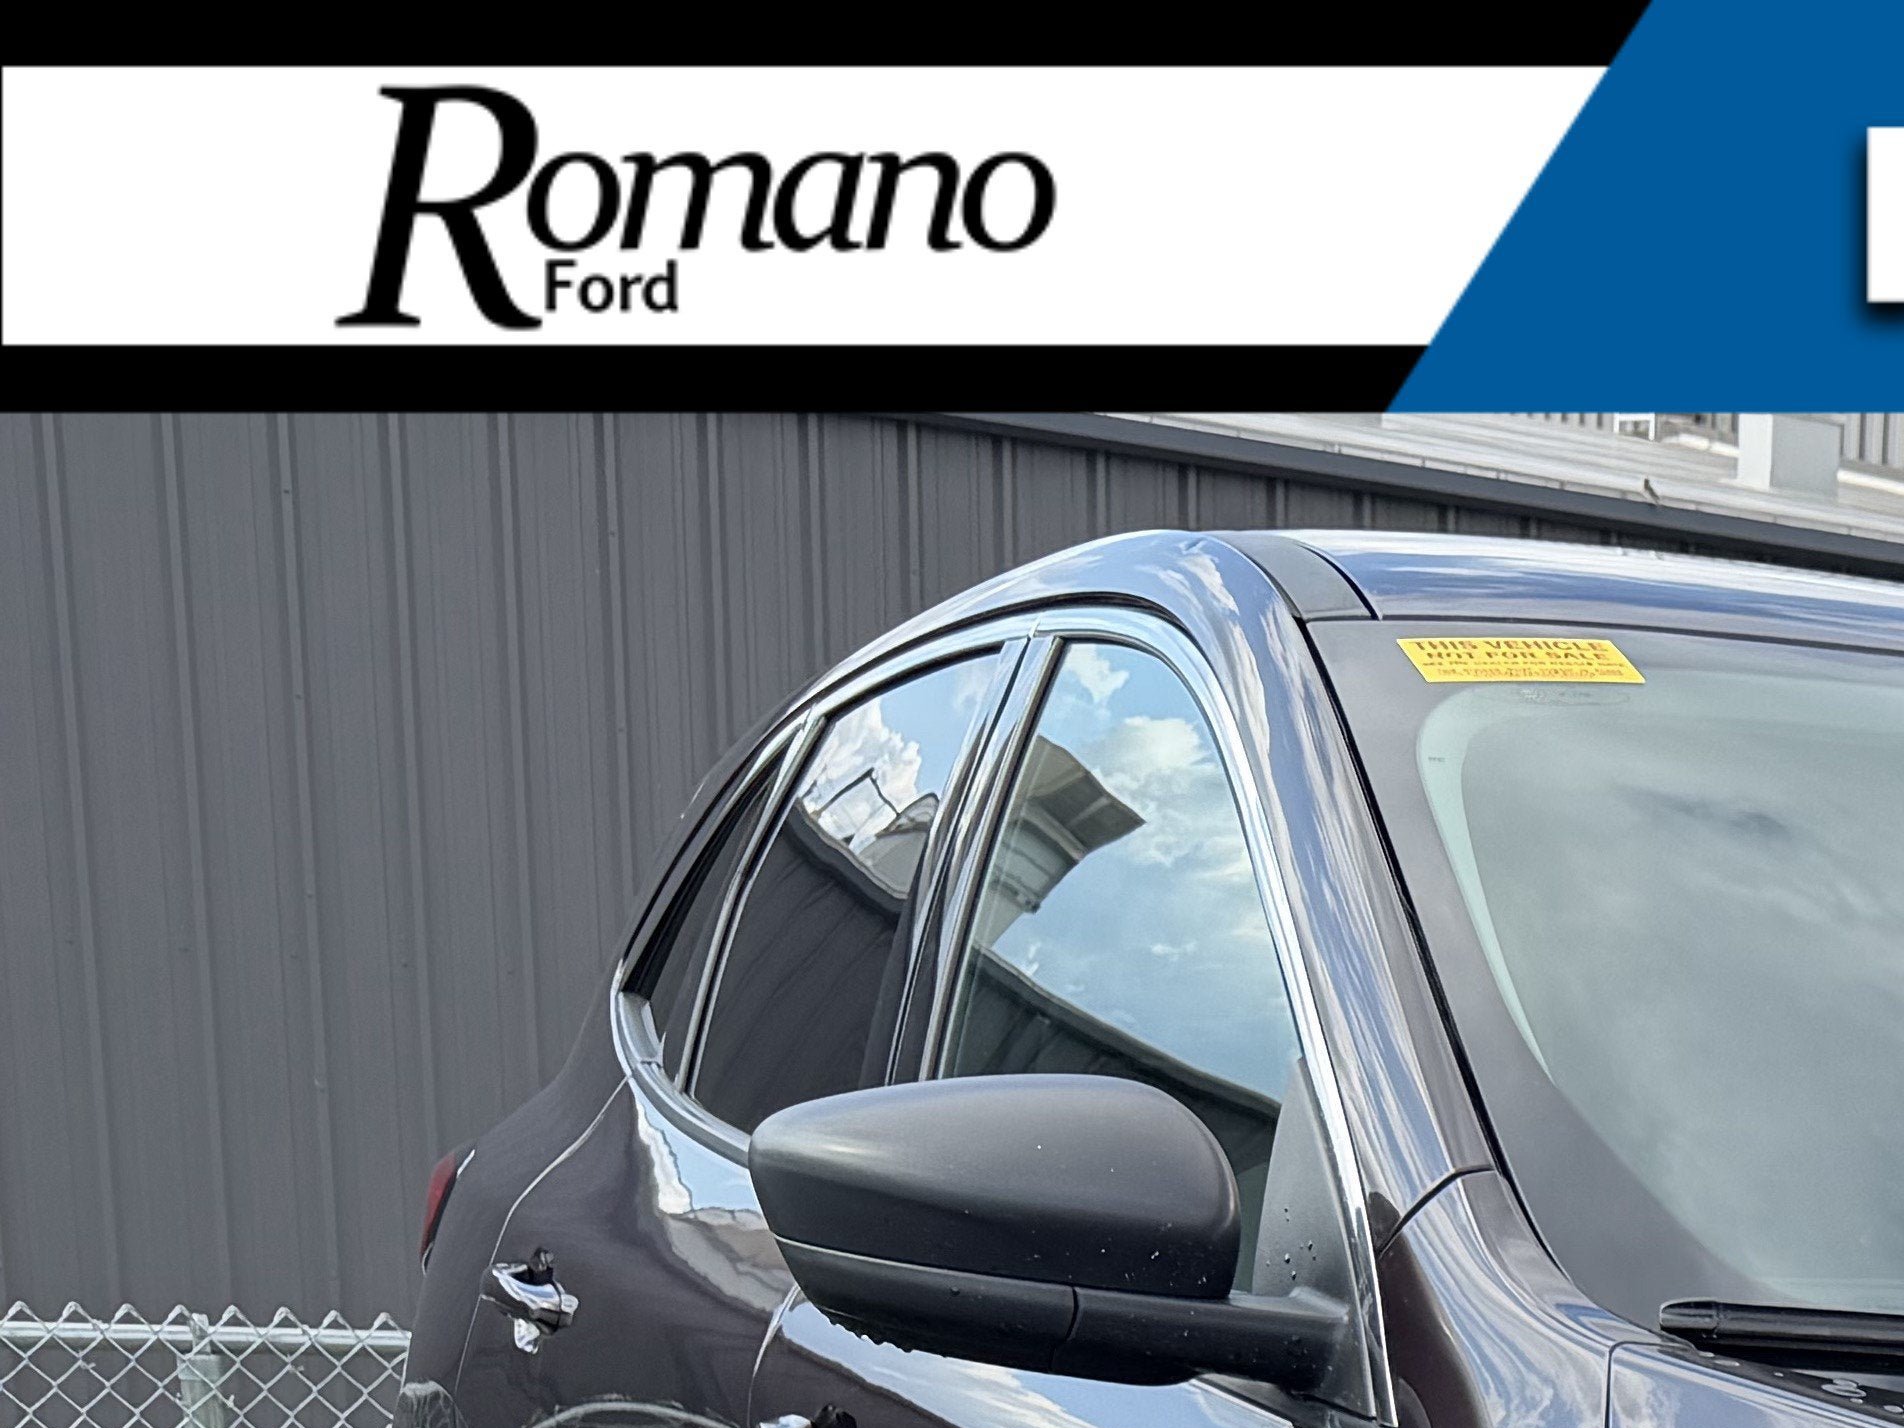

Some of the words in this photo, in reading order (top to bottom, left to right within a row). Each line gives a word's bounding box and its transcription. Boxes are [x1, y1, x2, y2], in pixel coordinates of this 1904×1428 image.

[1409, 641, 1478, 651] THIS
[1484, 641, 1608, 652] VEHICLE
[1545, 652, 1610, 660] SALE
